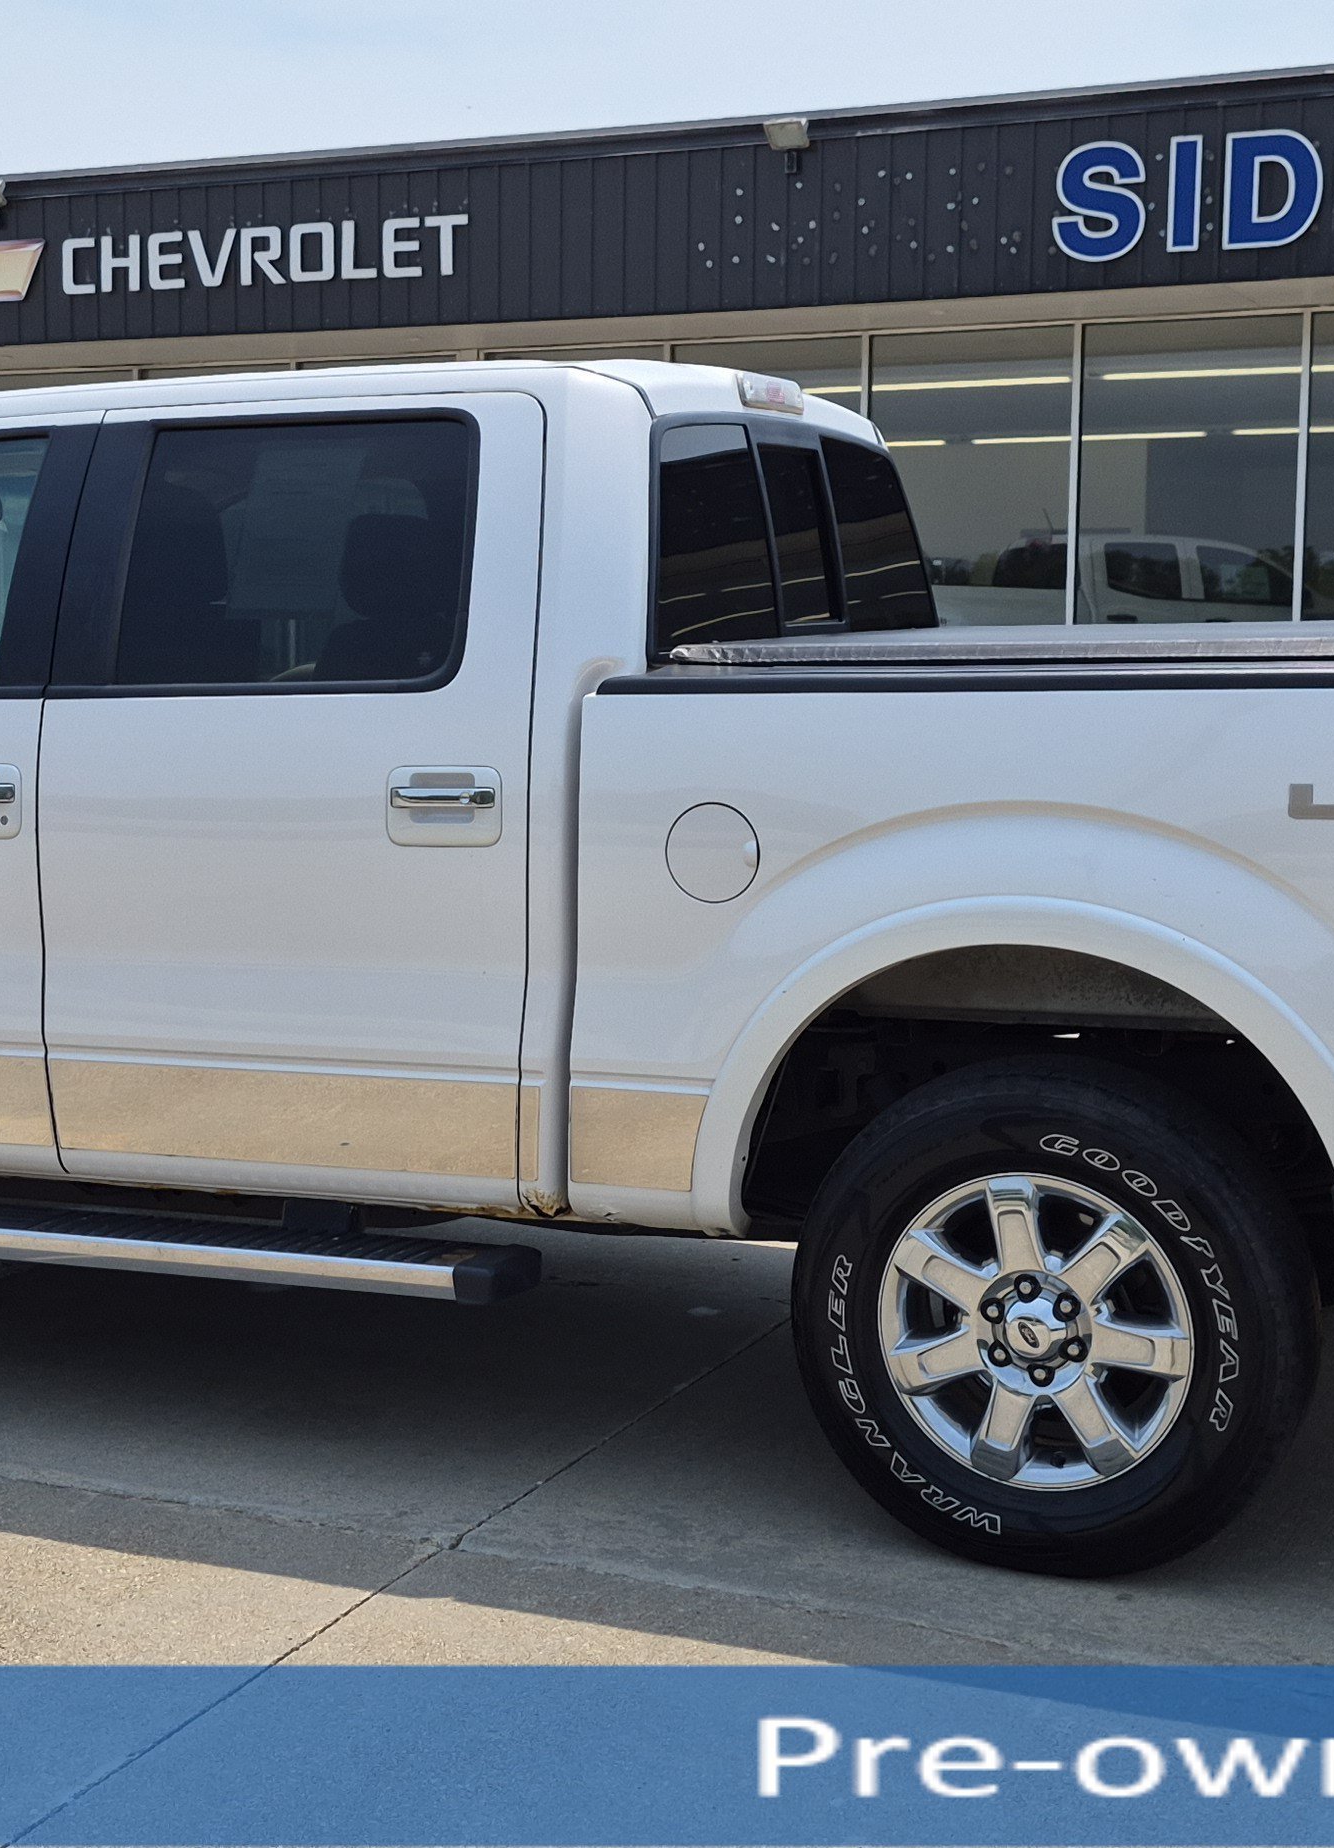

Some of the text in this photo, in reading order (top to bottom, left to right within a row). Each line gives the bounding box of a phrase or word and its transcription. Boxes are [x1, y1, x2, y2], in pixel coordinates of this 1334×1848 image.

[62, 213, 469, 295] CHEVROLET
[1052, 128, 1323, 262] SID
[1039, 1133, 1240, 1432] GOODYEAR
[828, 1254, 1002, 1536] WRANGLER
